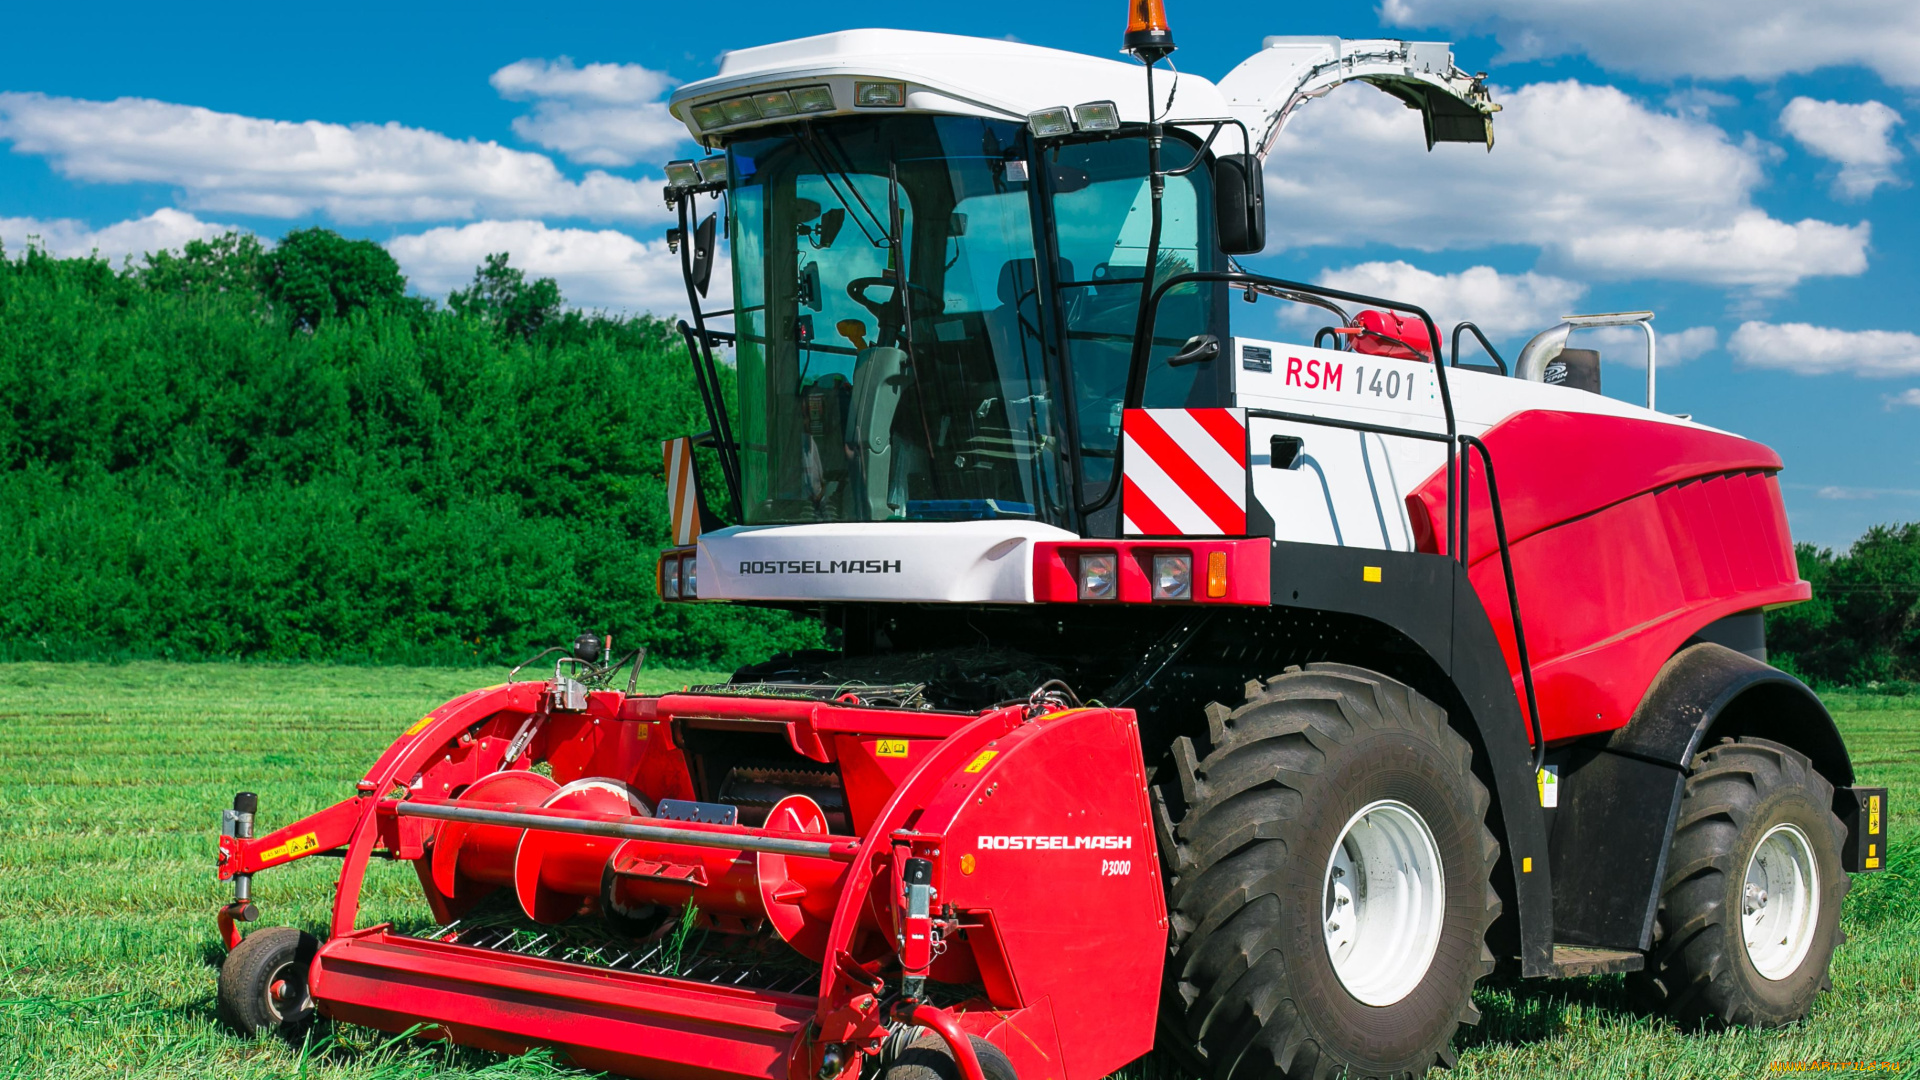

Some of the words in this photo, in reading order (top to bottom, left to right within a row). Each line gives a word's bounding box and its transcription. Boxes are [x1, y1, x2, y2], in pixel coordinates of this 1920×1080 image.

[1285, 356, 1343, 392] RSM
[1355, 366, 1414, 401] 1401
[739, 559, 901, 574] ROSTSELMASH
[977, 835, 1132, 850] ROSTSELMASH
[1101, 859, 1131, 876] P3000
